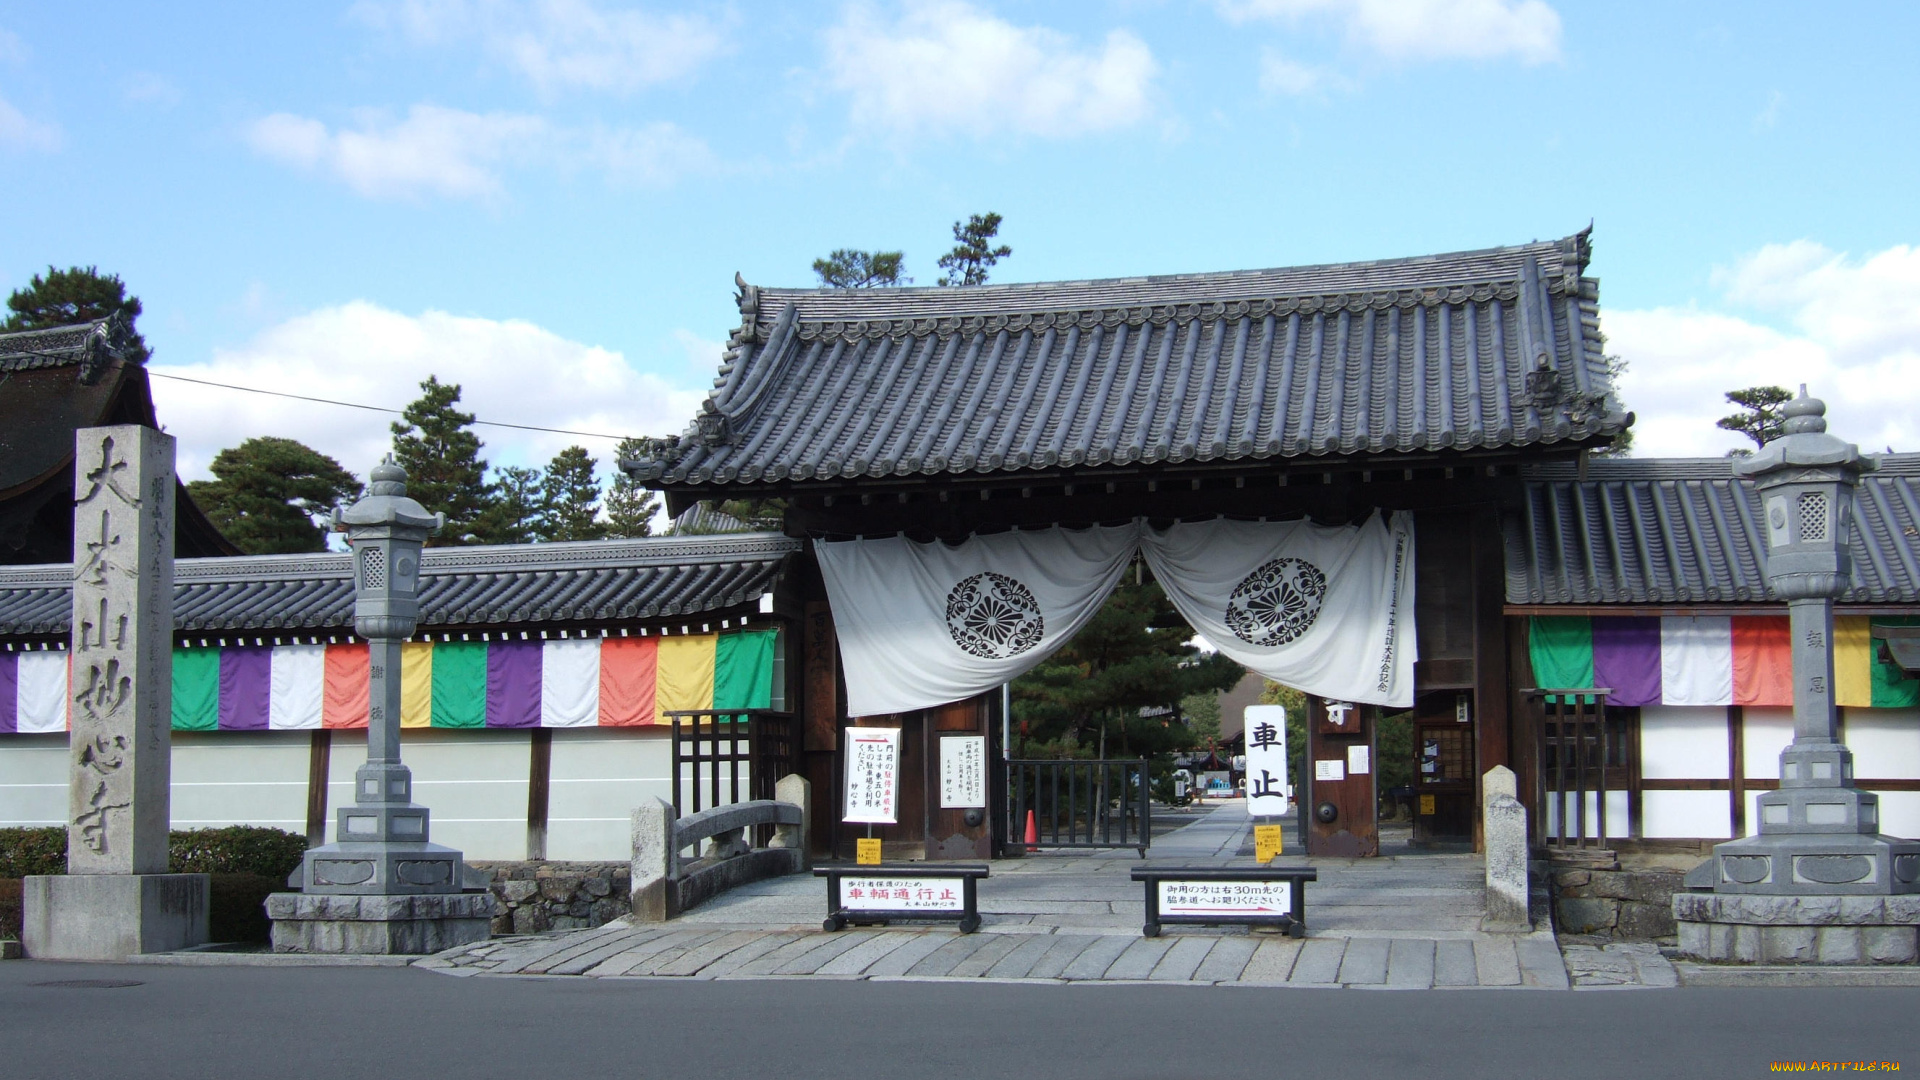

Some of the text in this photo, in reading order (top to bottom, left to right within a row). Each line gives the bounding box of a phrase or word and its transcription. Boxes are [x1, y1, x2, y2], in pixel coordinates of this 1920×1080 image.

[857, 744, 866, 772] ください
[1249, 722, 1284, 799] 車止
[865, 744, 874, 807] 先の駐車場を利用
[850, 783, 858, 808] 妙心寺
[1166, 885, 1284, 894] 御用の方は右30m先の
